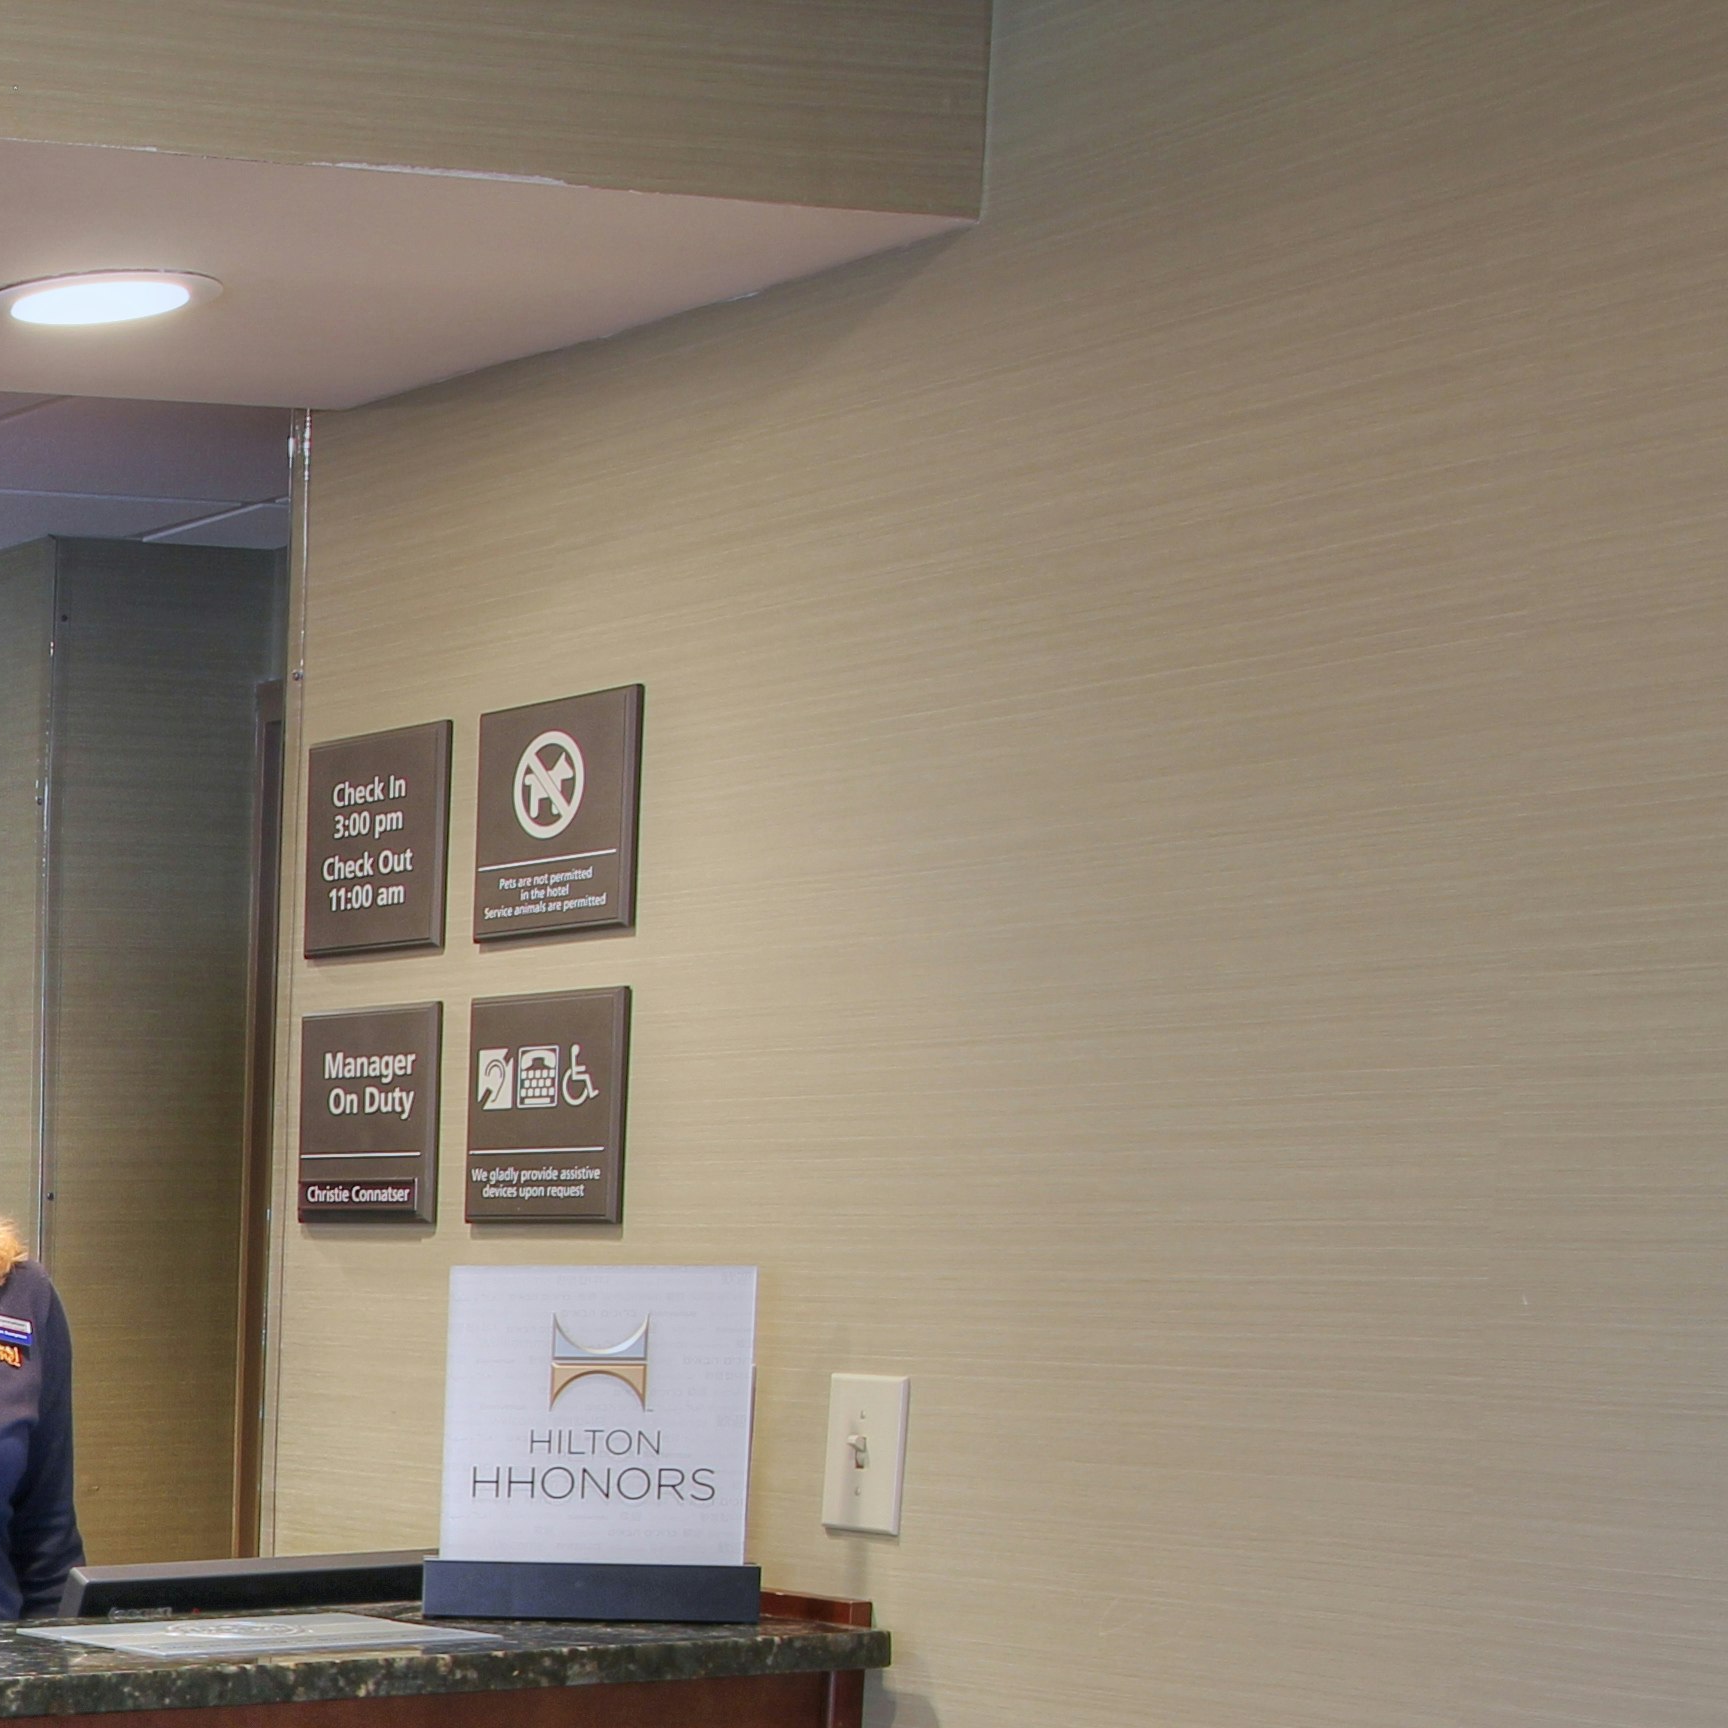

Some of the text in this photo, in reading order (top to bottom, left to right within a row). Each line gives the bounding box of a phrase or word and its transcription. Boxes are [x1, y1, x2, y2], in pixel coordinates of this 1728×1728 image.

[333, 775, 406, 807] Check In
[334, 811, 403, 839] 3:00 pm
[323, 848, 413, 881] Check Out
[499, 866, 593, 890] Pets are not permitted
[329, 884, 405, 911] 11:00 am
[484, 892, 607, 919] Service animals are permitted
[520, 884, 569, 901] in the hotel
[324, 1052, 416, 1084] Manager
[329, 1086, 414, 1120] On Duty
[471, 1165, 601, 1184] We gladly provide assistive
[307, 1185, 411, 1202] Christie Connatser
[482, 1183, 585, 1200] devices upon request
[529, 1429, 662, 1456] HILTON
[471, 1466, 716, 1501] HHONORS
